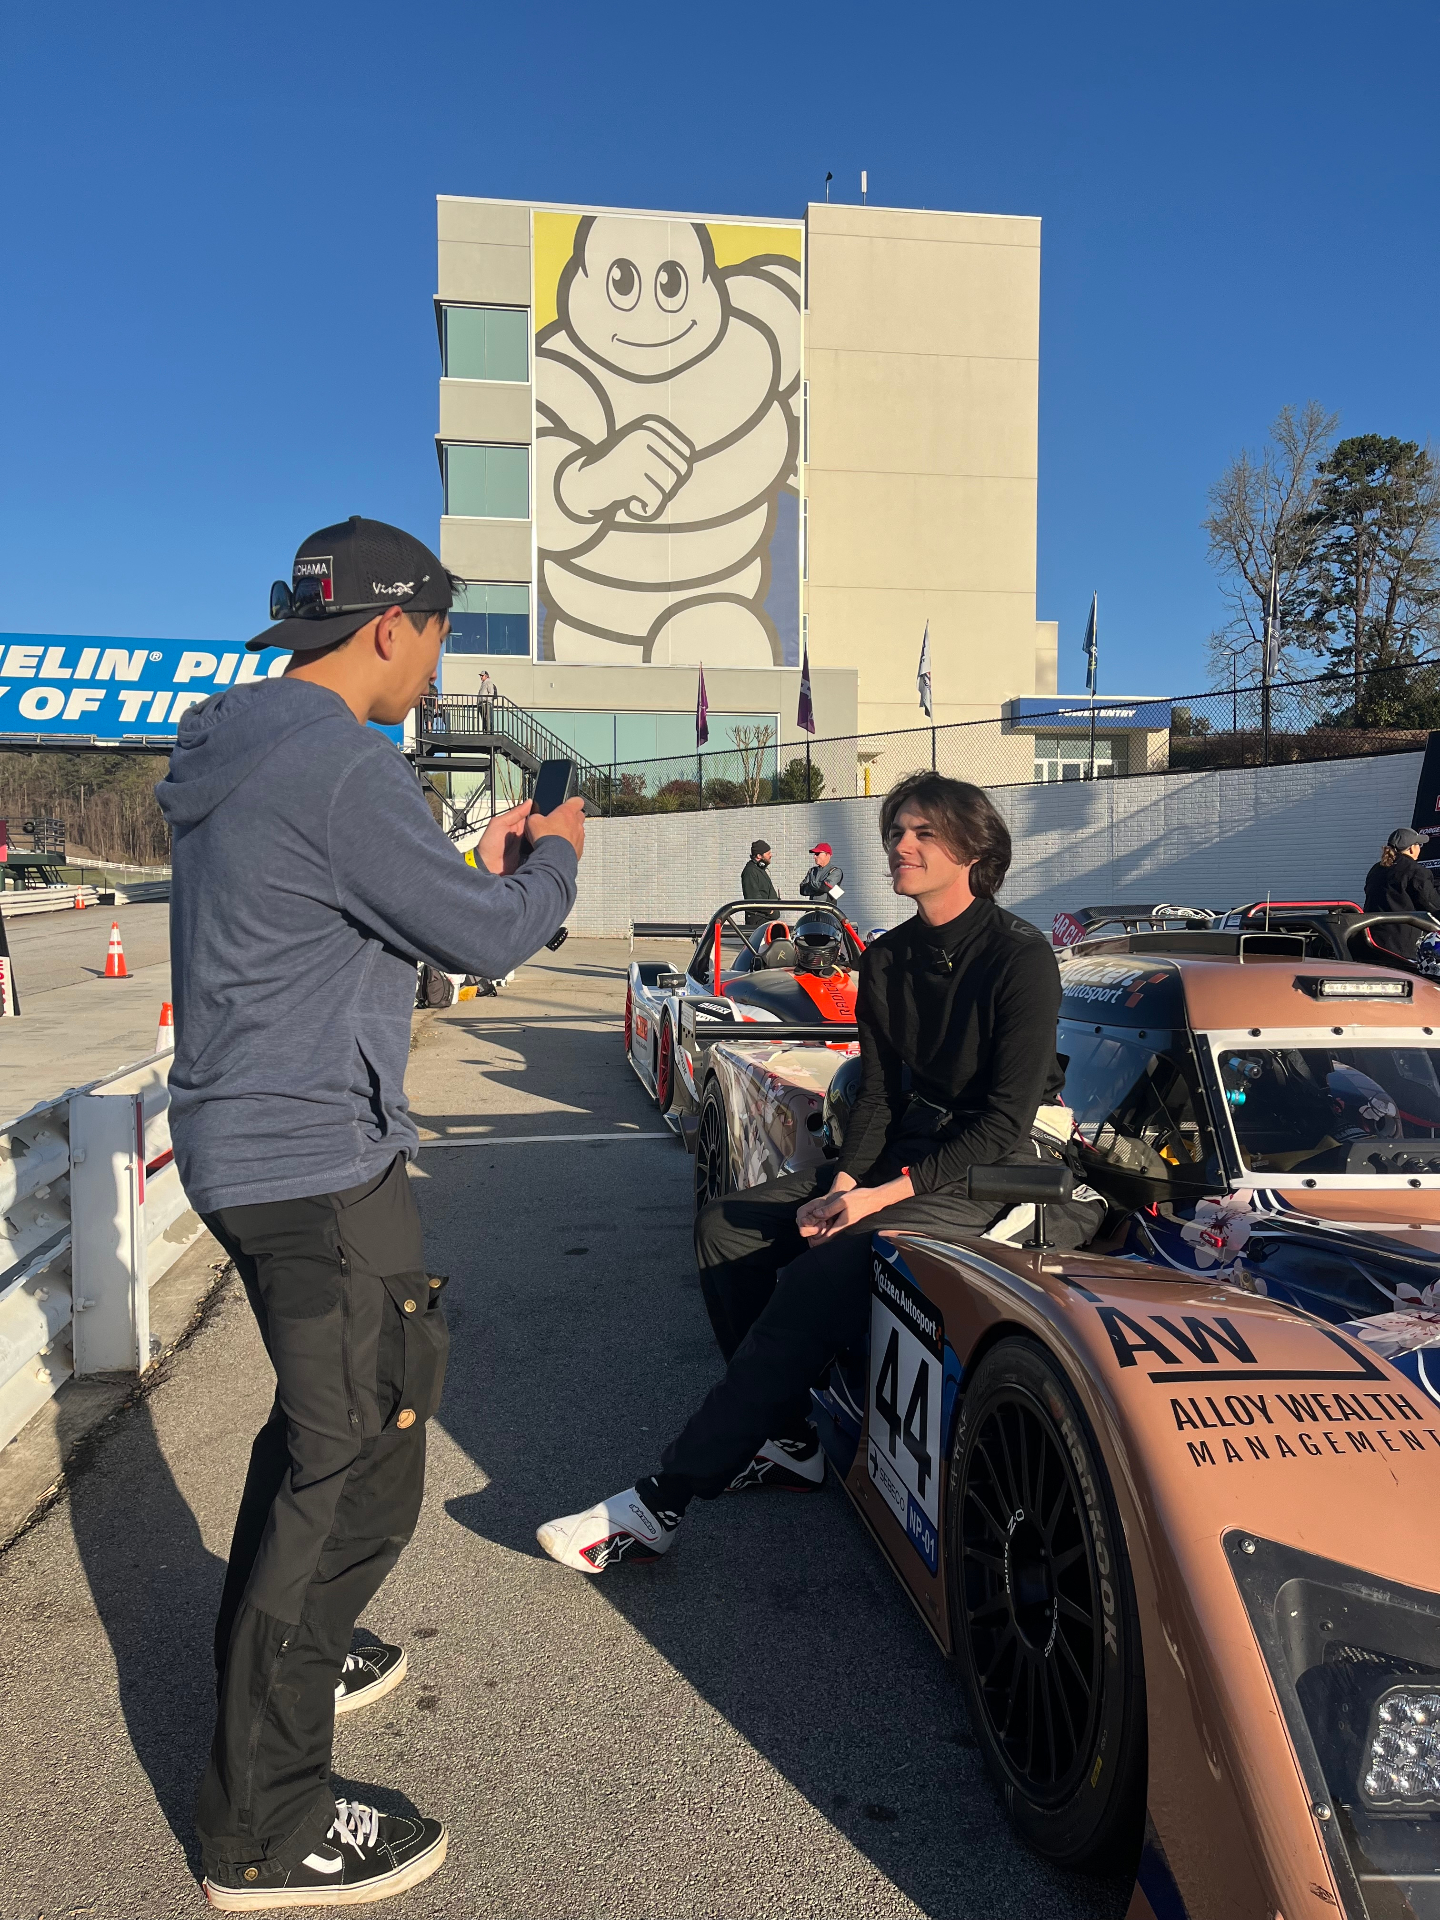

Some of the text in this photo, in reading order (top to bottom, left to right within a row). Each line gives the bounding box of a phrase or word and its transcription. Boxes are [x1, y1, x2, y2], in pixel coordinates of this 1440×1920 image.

[18, 686, 107, 721] OF
[1062, 982, 1122, 1003] Autosport
[874, 1259, 937, 1340] Kaizen Autosport
[1095, 1306, 1258, 1368] AW
[876, 1326, 932, 1501] 44
[1169, 1393, 1424, 1431] ALLOY WEALTH
[909, 1505, 935, 1562] NP-01
